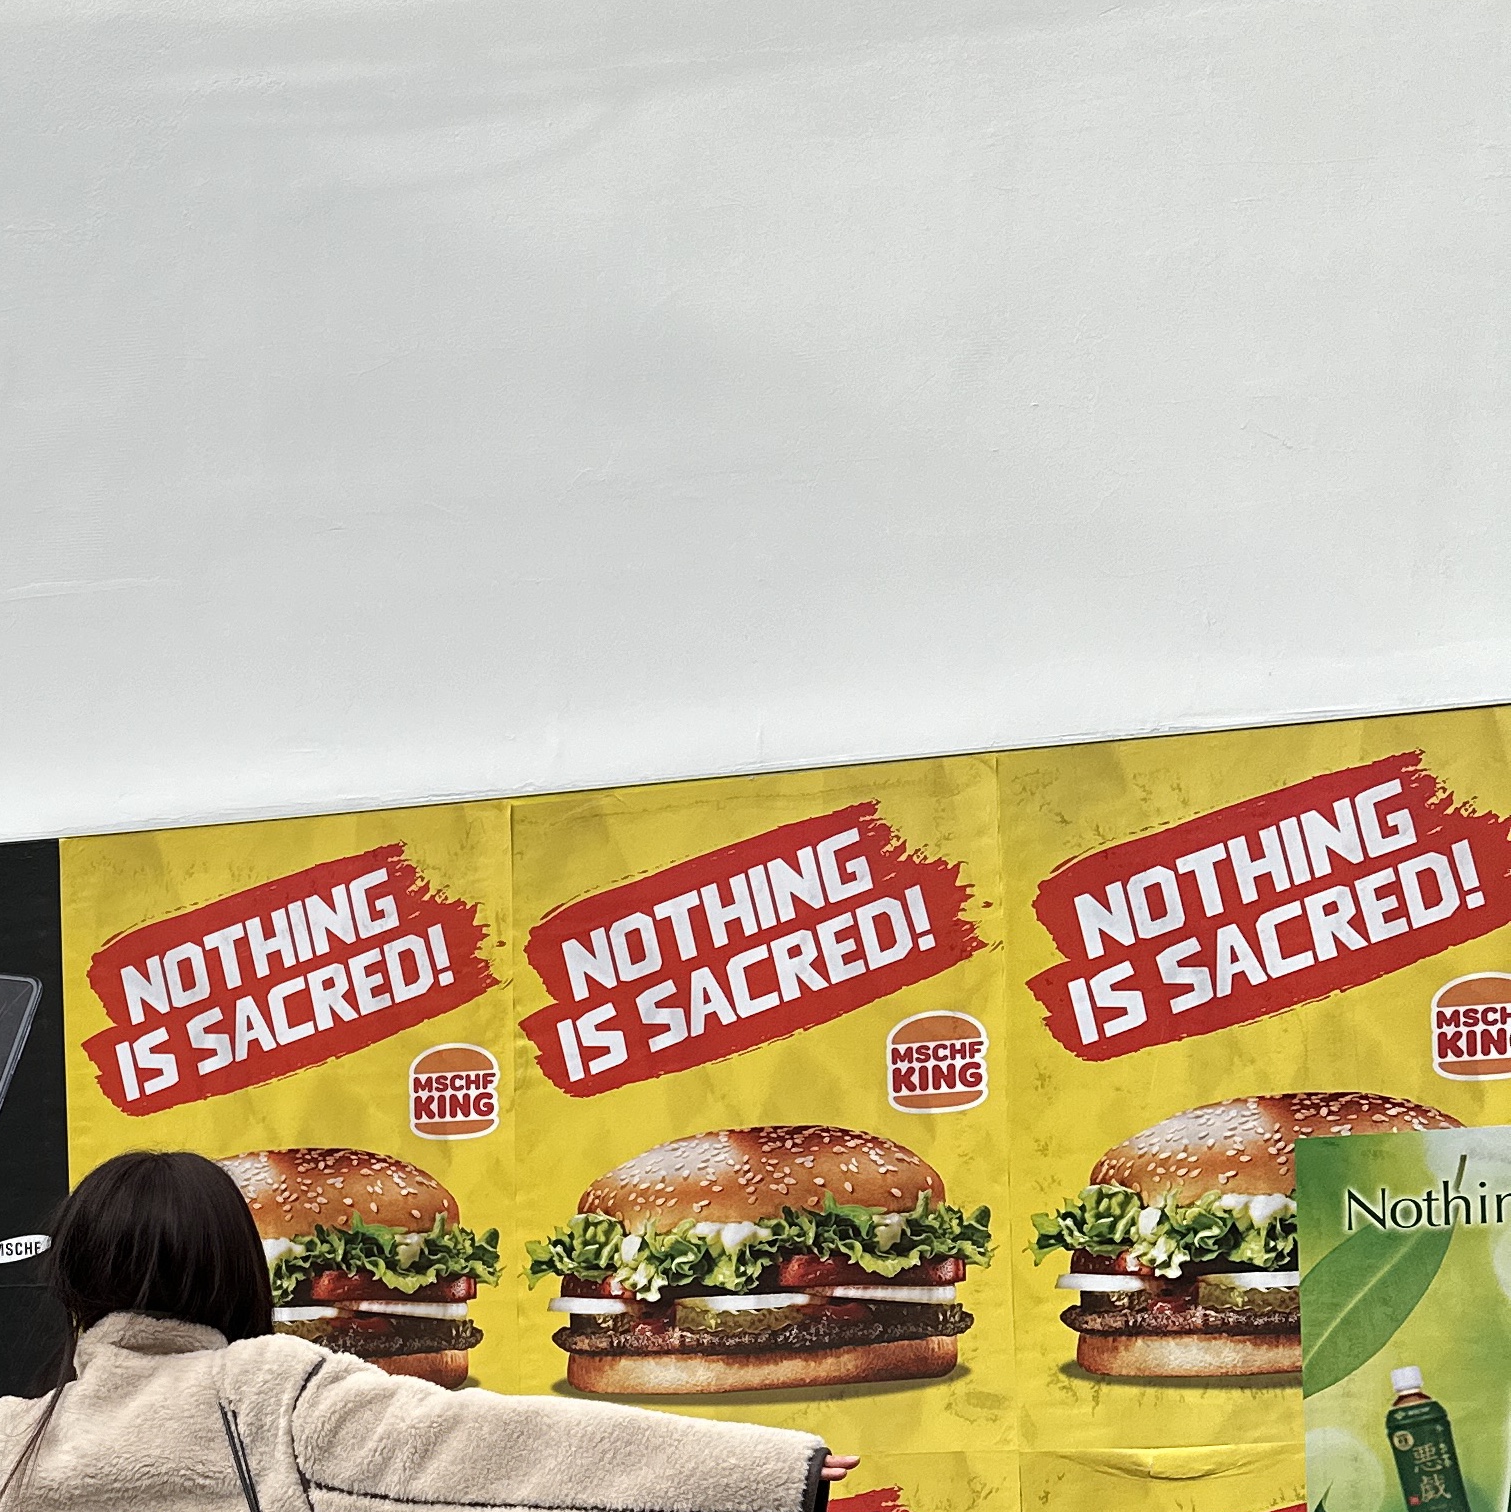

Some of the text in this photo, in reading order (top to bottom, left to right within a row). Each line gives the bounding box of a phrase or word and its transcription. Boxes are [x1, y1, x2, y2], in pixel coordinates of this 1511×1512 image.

[561, 827, 874, 1002] NOTHING
[1073, 778, 1417, 960] NOTHING
[119, 868, 401, 1026] NOTHING
[556, 884, 936, 1082] IS SACRED!
[1067, 839, 1486, 1045] IS SACRED!
[115, 923, 455, 1102] IS SACRED!
[891, 1041, 985, 1065] MSCHF
[1436, 1007, 1511, 1029] MSCH
[413, 1072, 497, 1093] MSCHF
[413, 1092, 495, 1119] KING
[892, 1062, 984, 1093] KING
[1347, 1180, 1511, 1230] Nothin
